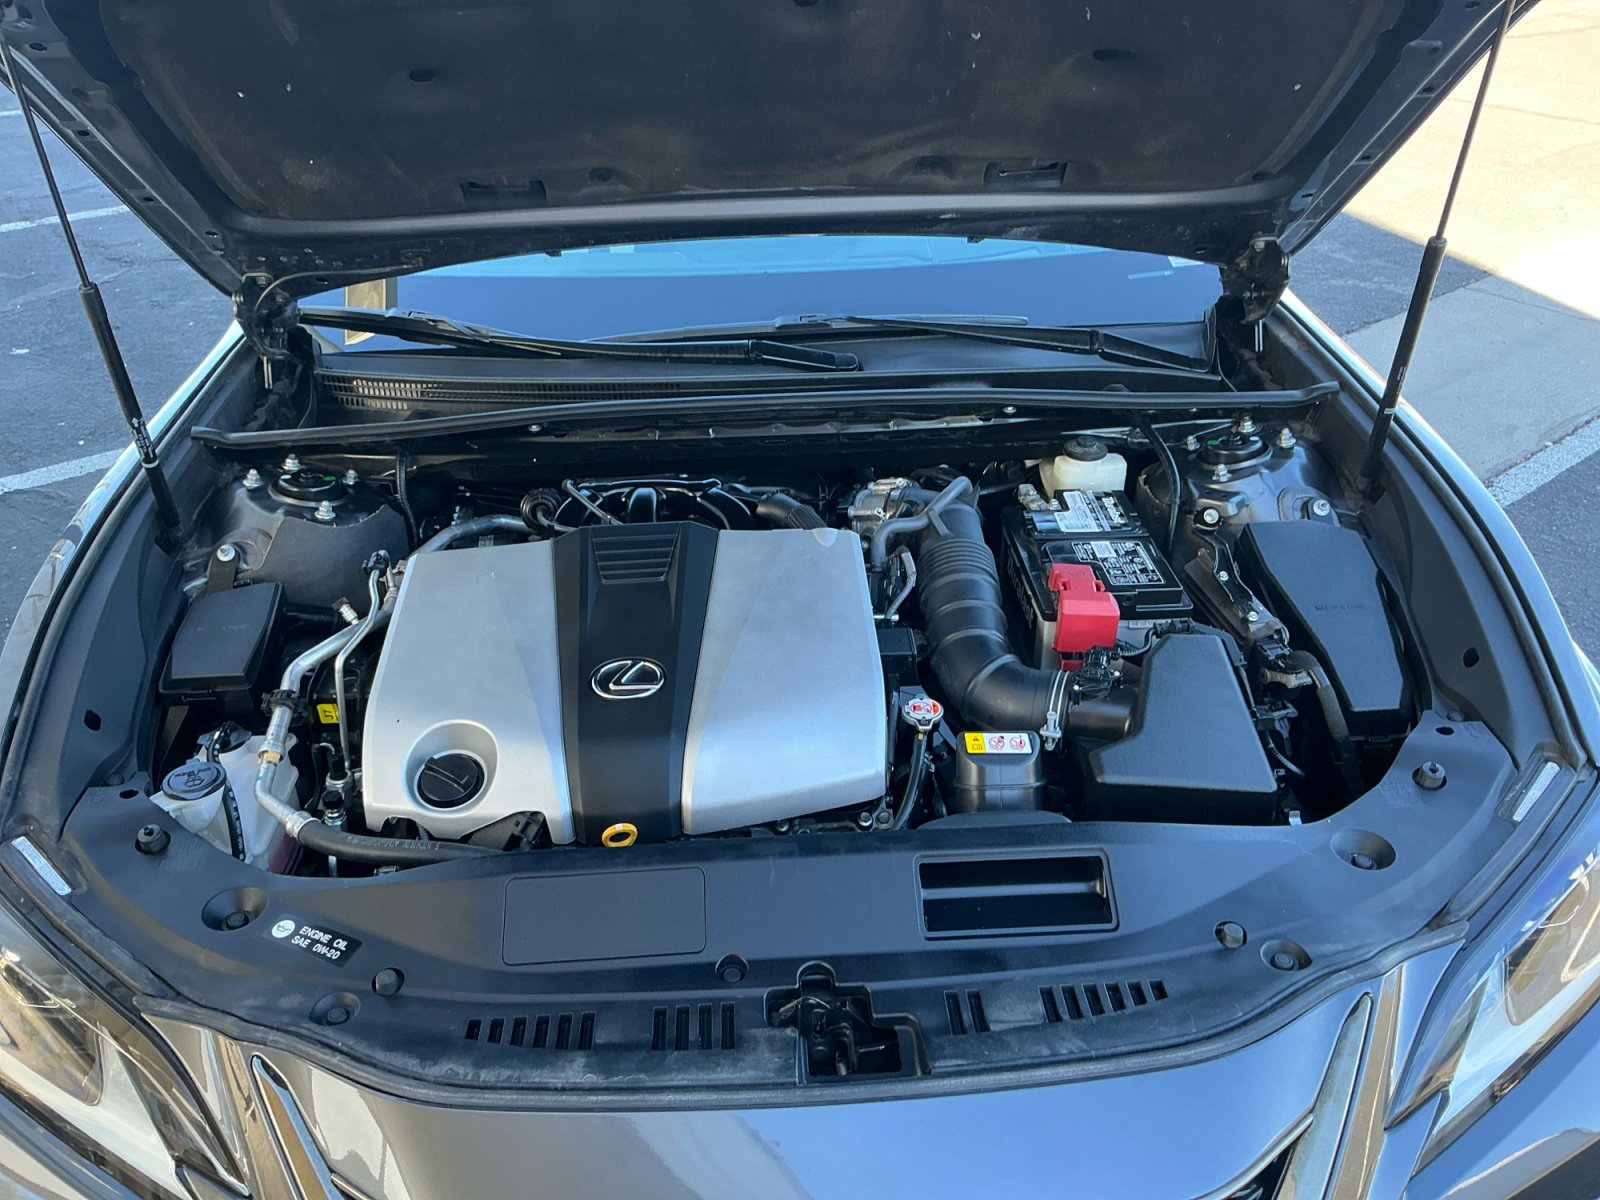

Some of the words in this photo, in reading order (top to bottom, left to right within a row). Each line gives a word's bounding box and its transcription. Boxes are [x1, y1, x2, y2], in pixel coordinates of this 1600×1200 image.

[291, 935, 311, 948] SAE
[312, 943, 341, 960] 0W-20
[299, 926, 332, 944] ENGINE
[333, 938, 348, 951] OIL
